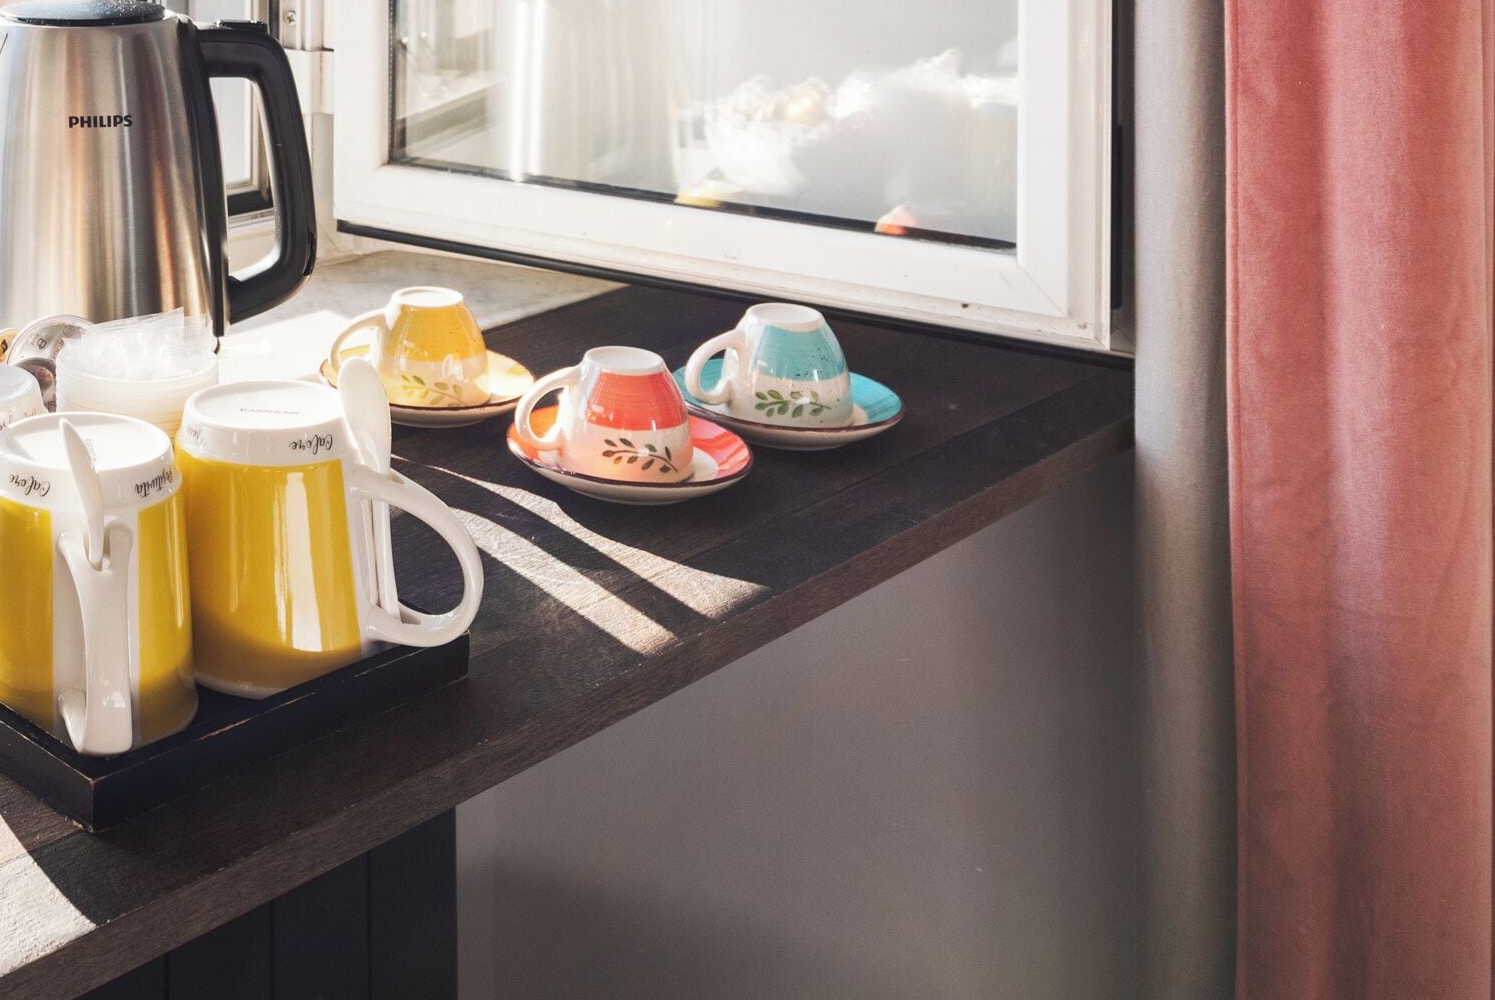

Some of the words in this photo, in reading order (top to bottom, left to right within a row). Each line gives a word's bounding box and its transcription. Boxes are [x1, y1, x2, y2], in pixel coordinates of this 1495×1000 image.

[68, 114, 133, 128] PHILIPS
[287, 433, 334, 456] Calore
[9, 474, 51, 498] Calore
